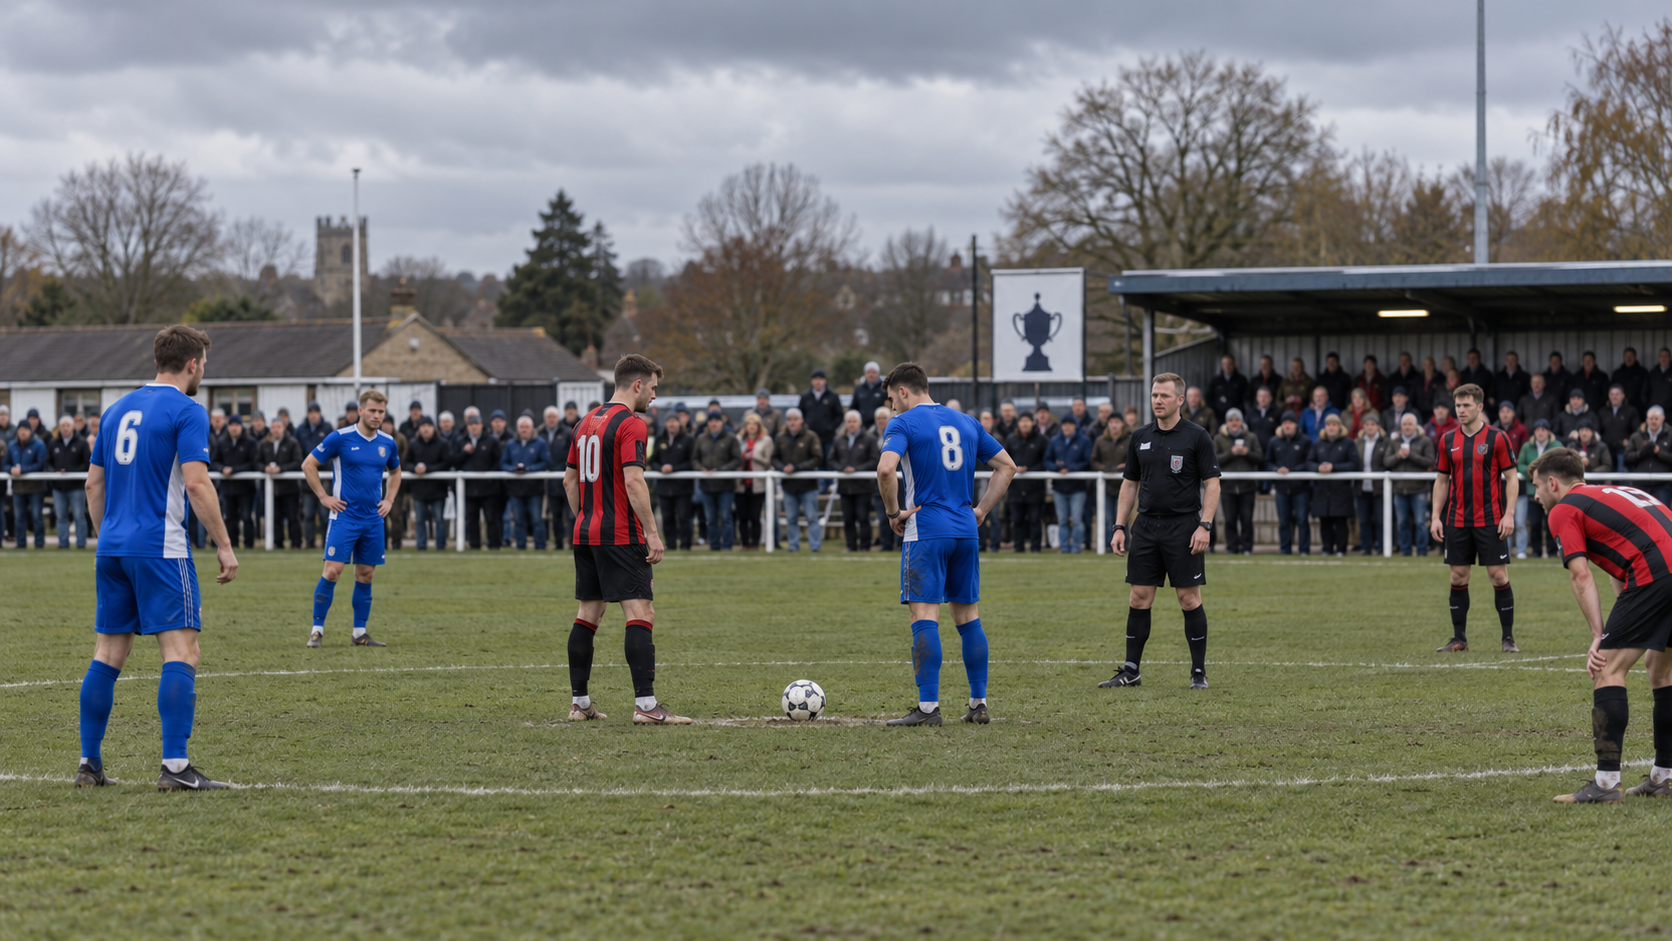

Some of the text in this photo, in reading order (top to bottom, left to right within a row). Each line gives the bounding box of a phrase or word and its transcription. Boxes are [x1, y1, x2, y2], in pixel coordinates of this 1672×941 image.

[115, 411, 142, 465] 6
[577, 434, 600, 482] 10
[939, 426, 963, 470] 8
